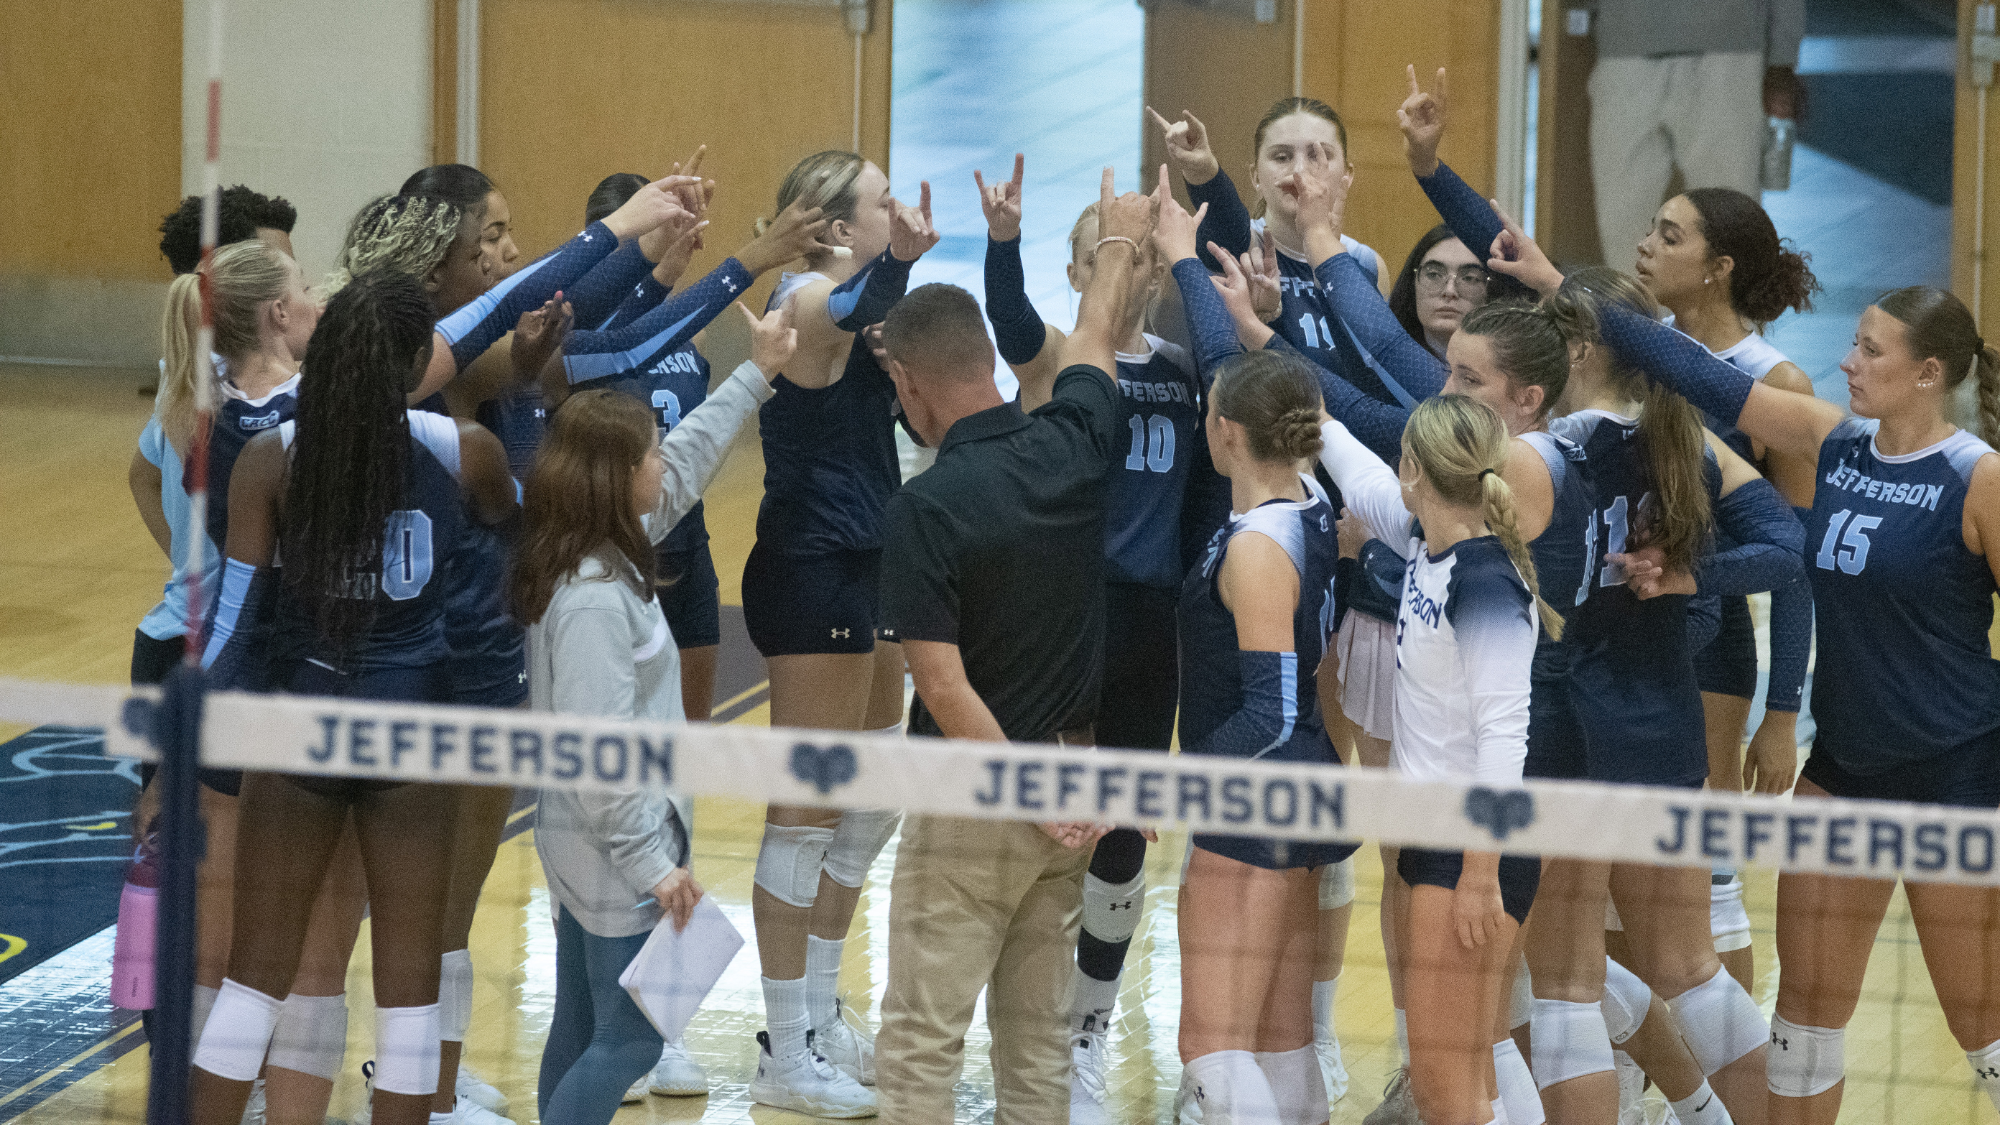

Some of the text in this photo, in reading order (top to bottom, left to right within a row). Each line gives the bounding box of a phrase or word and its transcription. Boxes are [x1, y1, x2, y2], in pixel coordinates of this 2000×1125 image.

[651, 389, 682, 448] 3
[1125, 413, 1175, 473] 10
[1825, 457, 1945, 512] JEFFERSON
[1816, 508, 1884, 576] 15
[307, 714, 674, 786] JEFFERSON
[974, 758, 1345, 831] JEFFERSON
[1655, 804, 1994, 874] JEFFERSO
